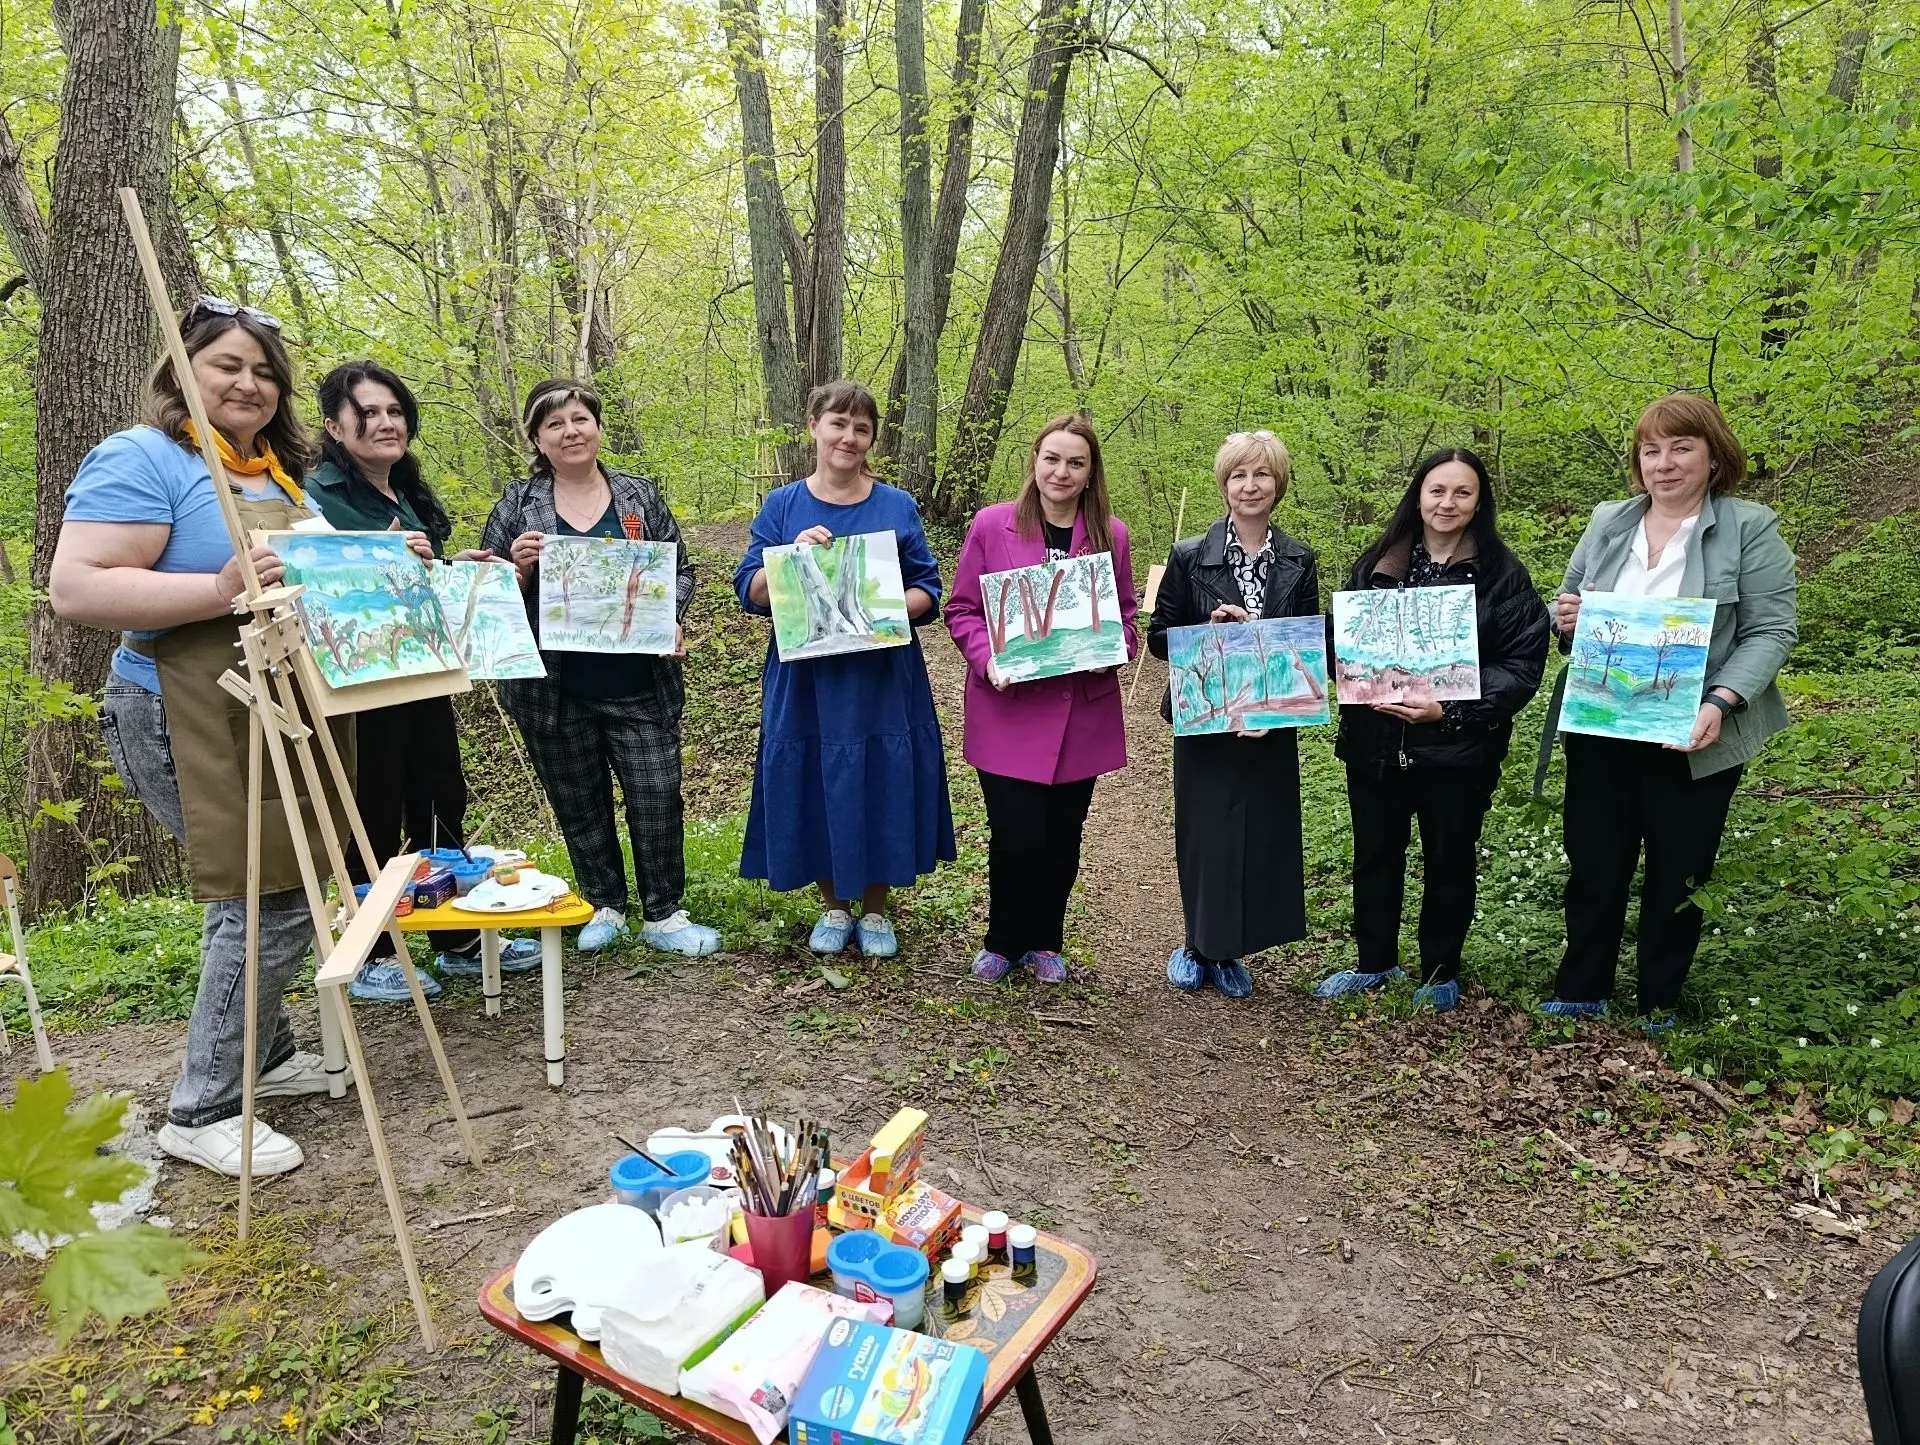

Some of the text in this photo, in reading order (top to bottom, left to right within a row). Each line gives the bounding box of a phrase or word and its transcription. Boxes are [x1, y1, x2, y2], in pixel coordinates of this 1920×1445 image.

[841, 1191, 880, 1209] 6 ЦВЕТОВ
[848, 1335, 875, 1380] гуашь
[936, 1344, 949, 1356] 12
